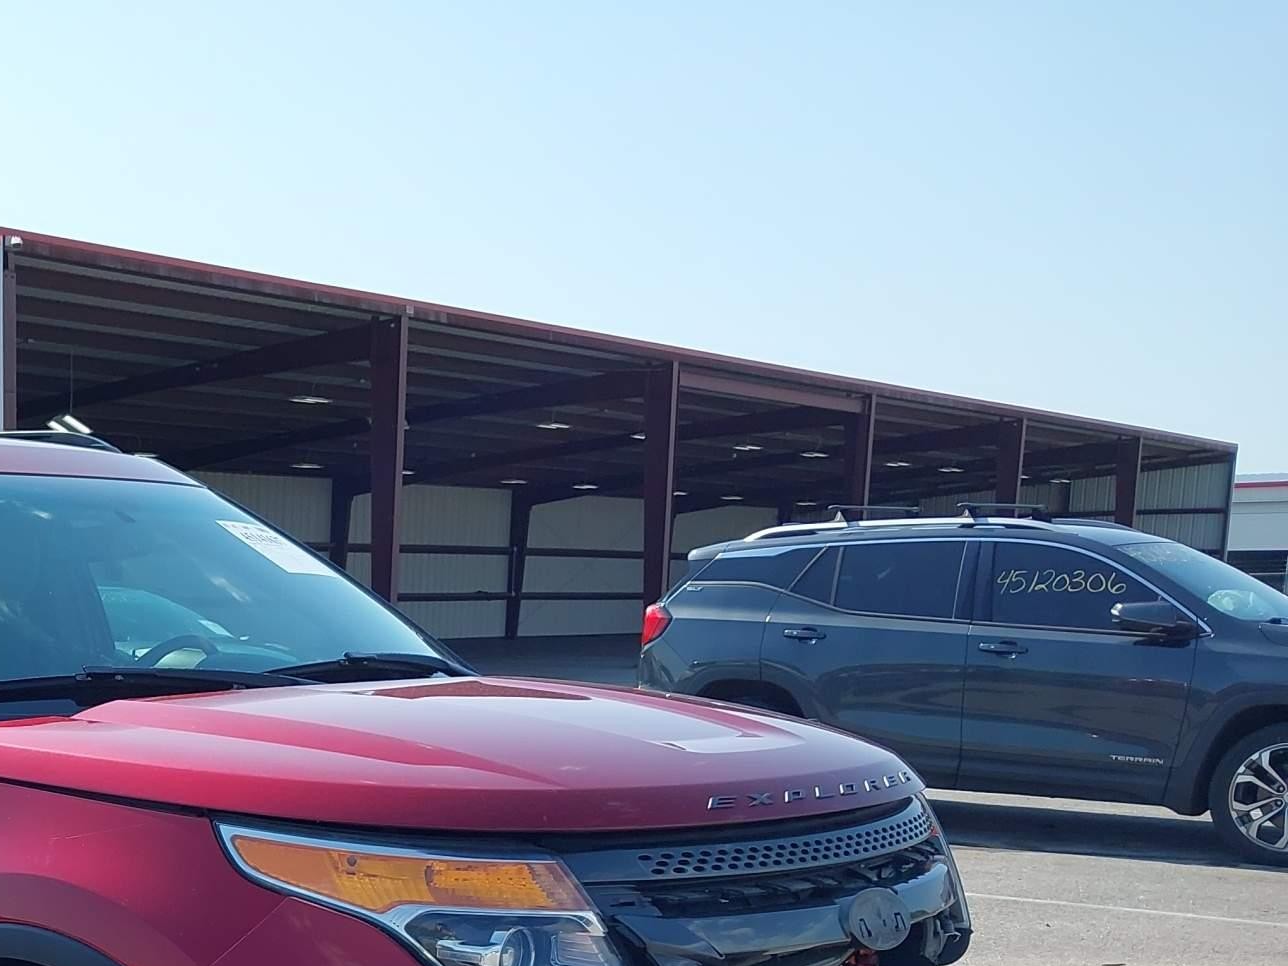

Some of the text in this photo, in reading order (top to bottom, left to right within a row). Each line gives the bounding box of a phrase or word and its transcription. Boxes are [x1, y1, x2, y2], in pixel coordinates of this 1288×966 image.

[996, 568, 1127, 595] 45120306
[1110, 754, 1164, 766] TERRAIN
[707, 770, 912, 811] EXPLORER
